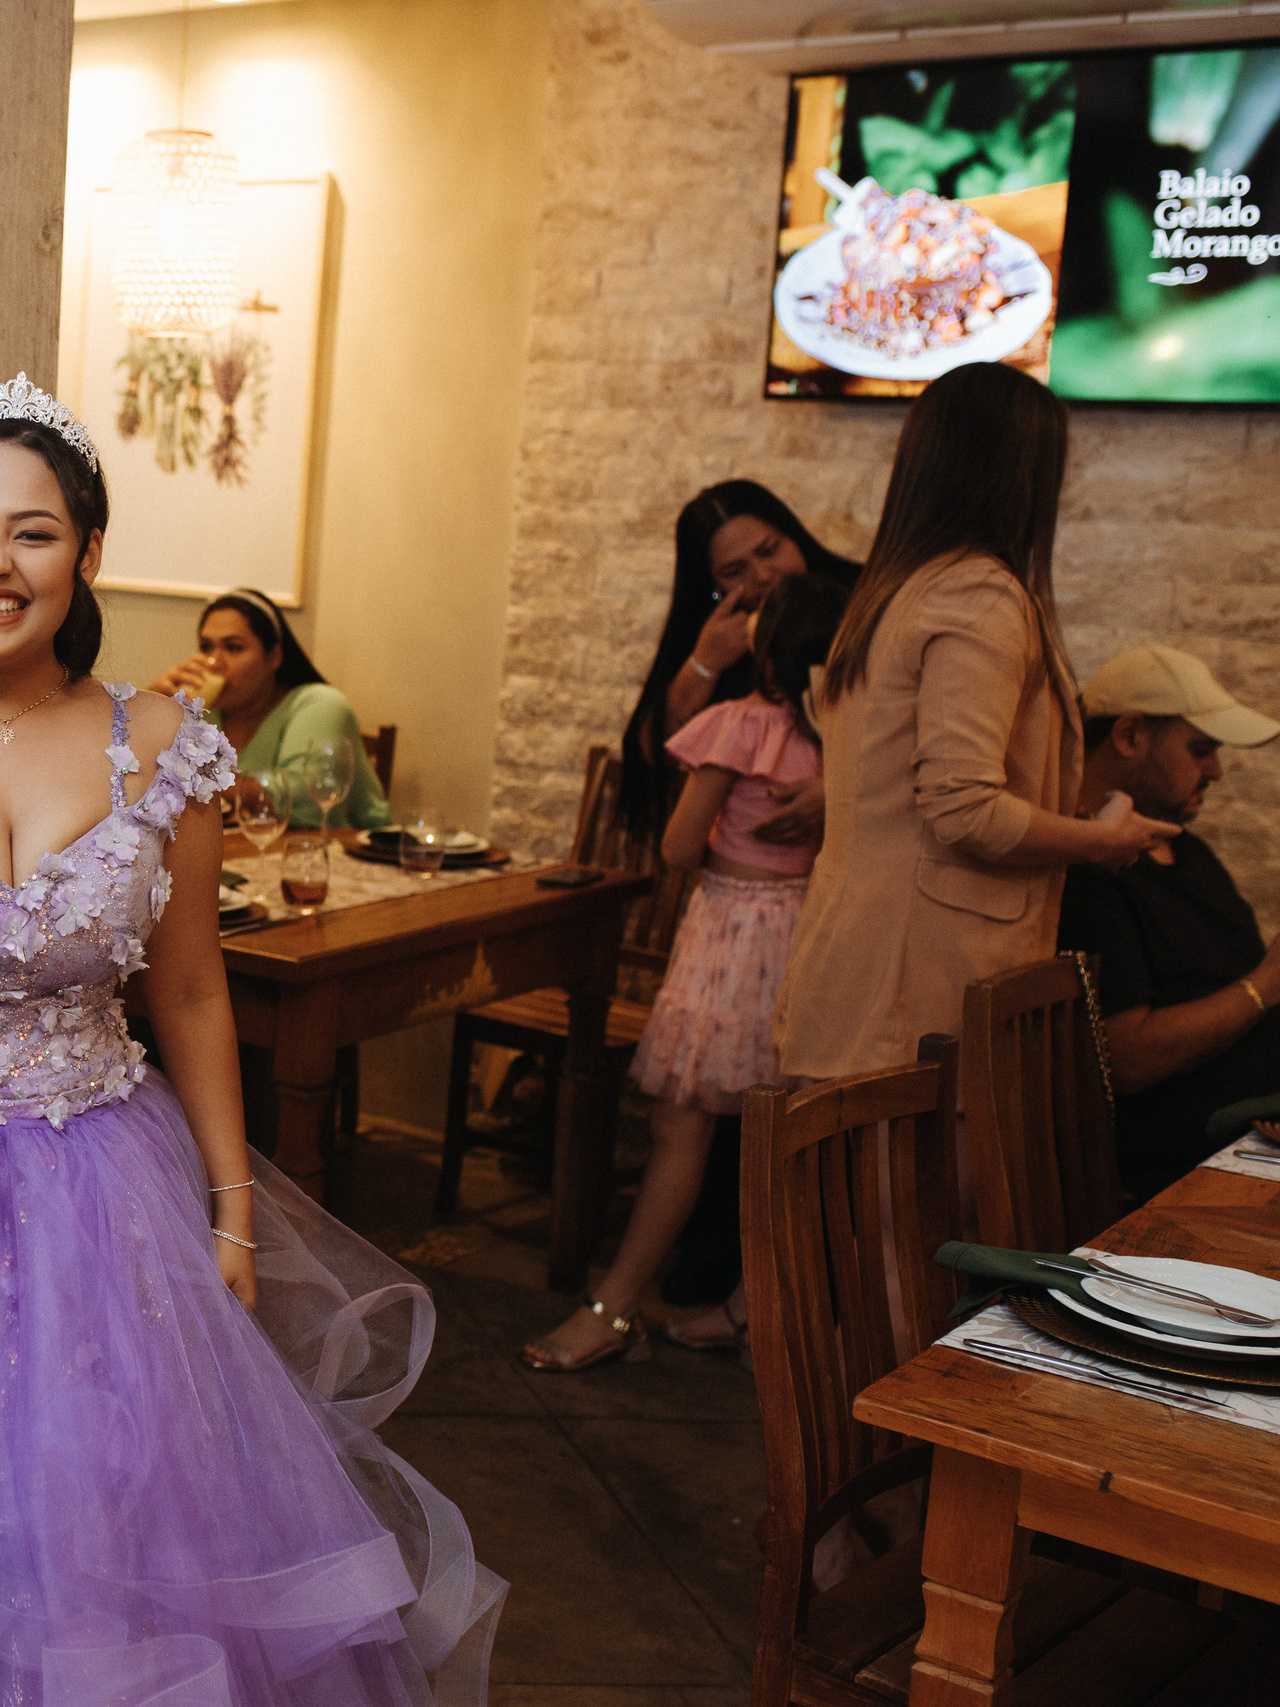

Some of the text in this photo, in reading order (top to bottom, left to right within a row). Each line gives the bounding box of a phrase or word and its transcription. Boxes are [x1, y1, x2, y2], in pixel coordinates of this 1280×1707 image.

[1157, 167, 1251, 199] Balaio
[1153, 197, 1261, 229] Gelado
[1150, 228, 1280, 265] Morango
